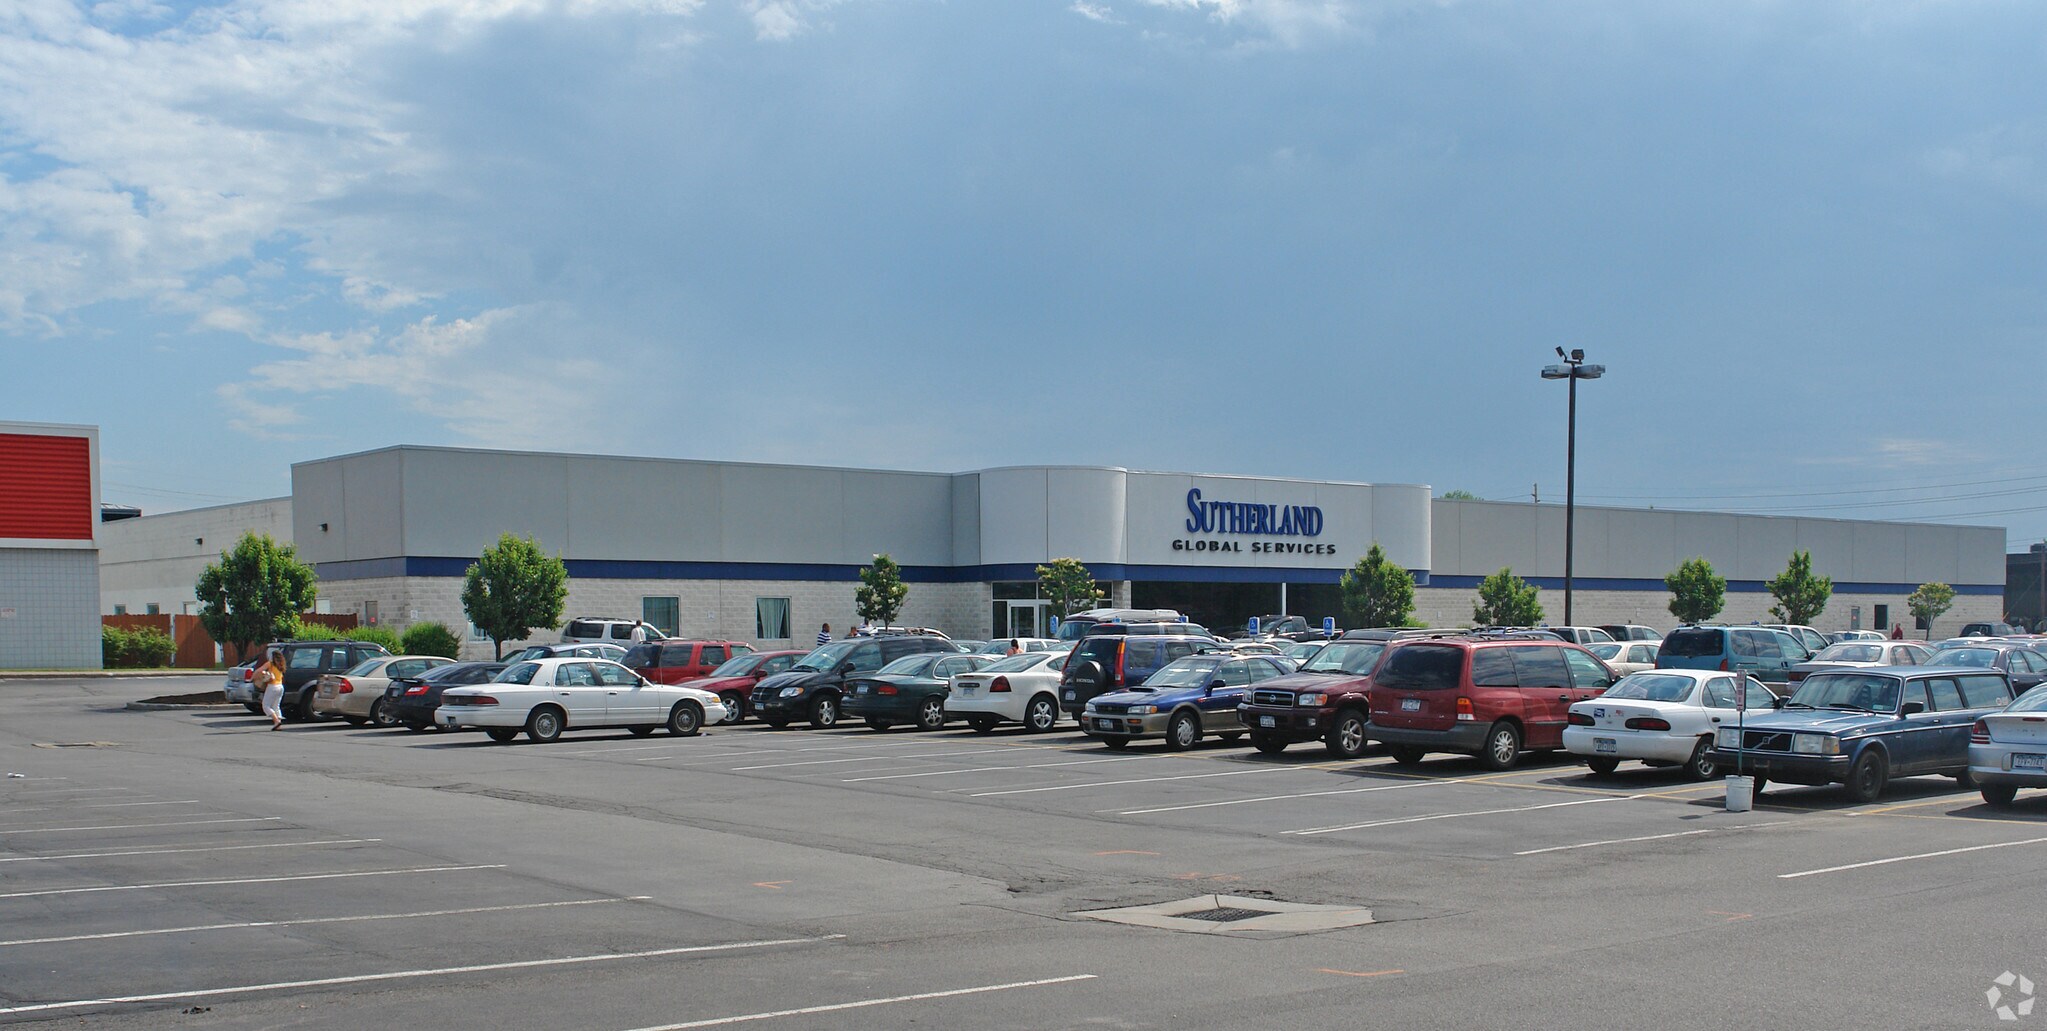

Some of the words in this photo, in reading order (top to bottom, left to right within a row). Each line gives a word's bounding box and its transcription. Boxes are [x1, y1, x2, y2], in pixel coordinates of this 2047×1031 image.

[1186, 488, 1324, 537] SUTHERLAND
[1172, 539, 1243, 552] GLOBAL
[1251, 541, 1337, 555] SERVICES
